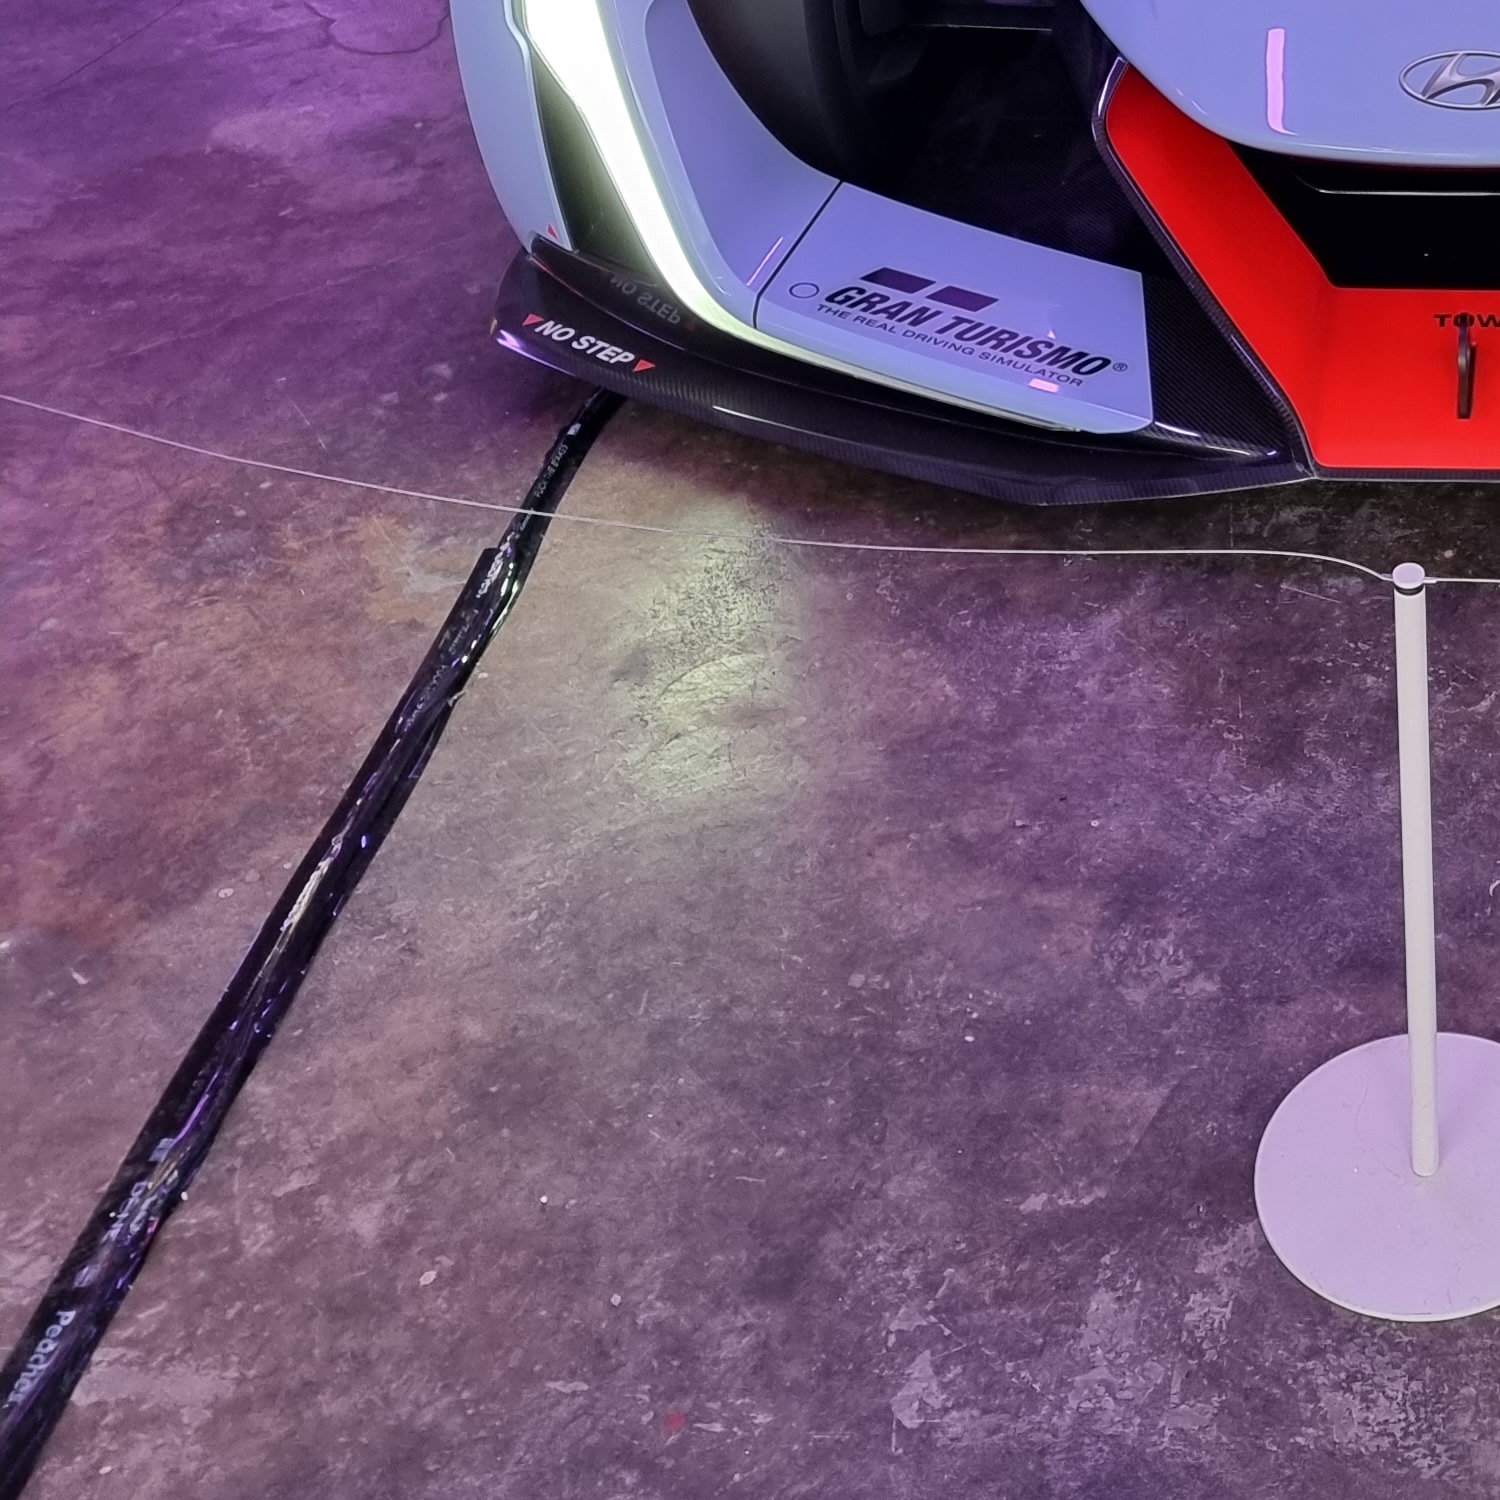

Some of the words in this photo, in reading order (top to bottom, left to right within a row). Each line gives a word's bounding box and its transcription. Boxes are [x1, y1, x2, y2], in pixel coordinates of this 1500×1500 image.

[825, 286, 941, 328] GRAN
[534, 320, 576, 342] NO
[571, 335, 636, 365] STEP
[816, 303, 852, 320] THE
[853, 313, 897, 335] REAL
[902, 328, 975, 356] DRIVING
[978, 351, 1084, 388] SIMULATOR
